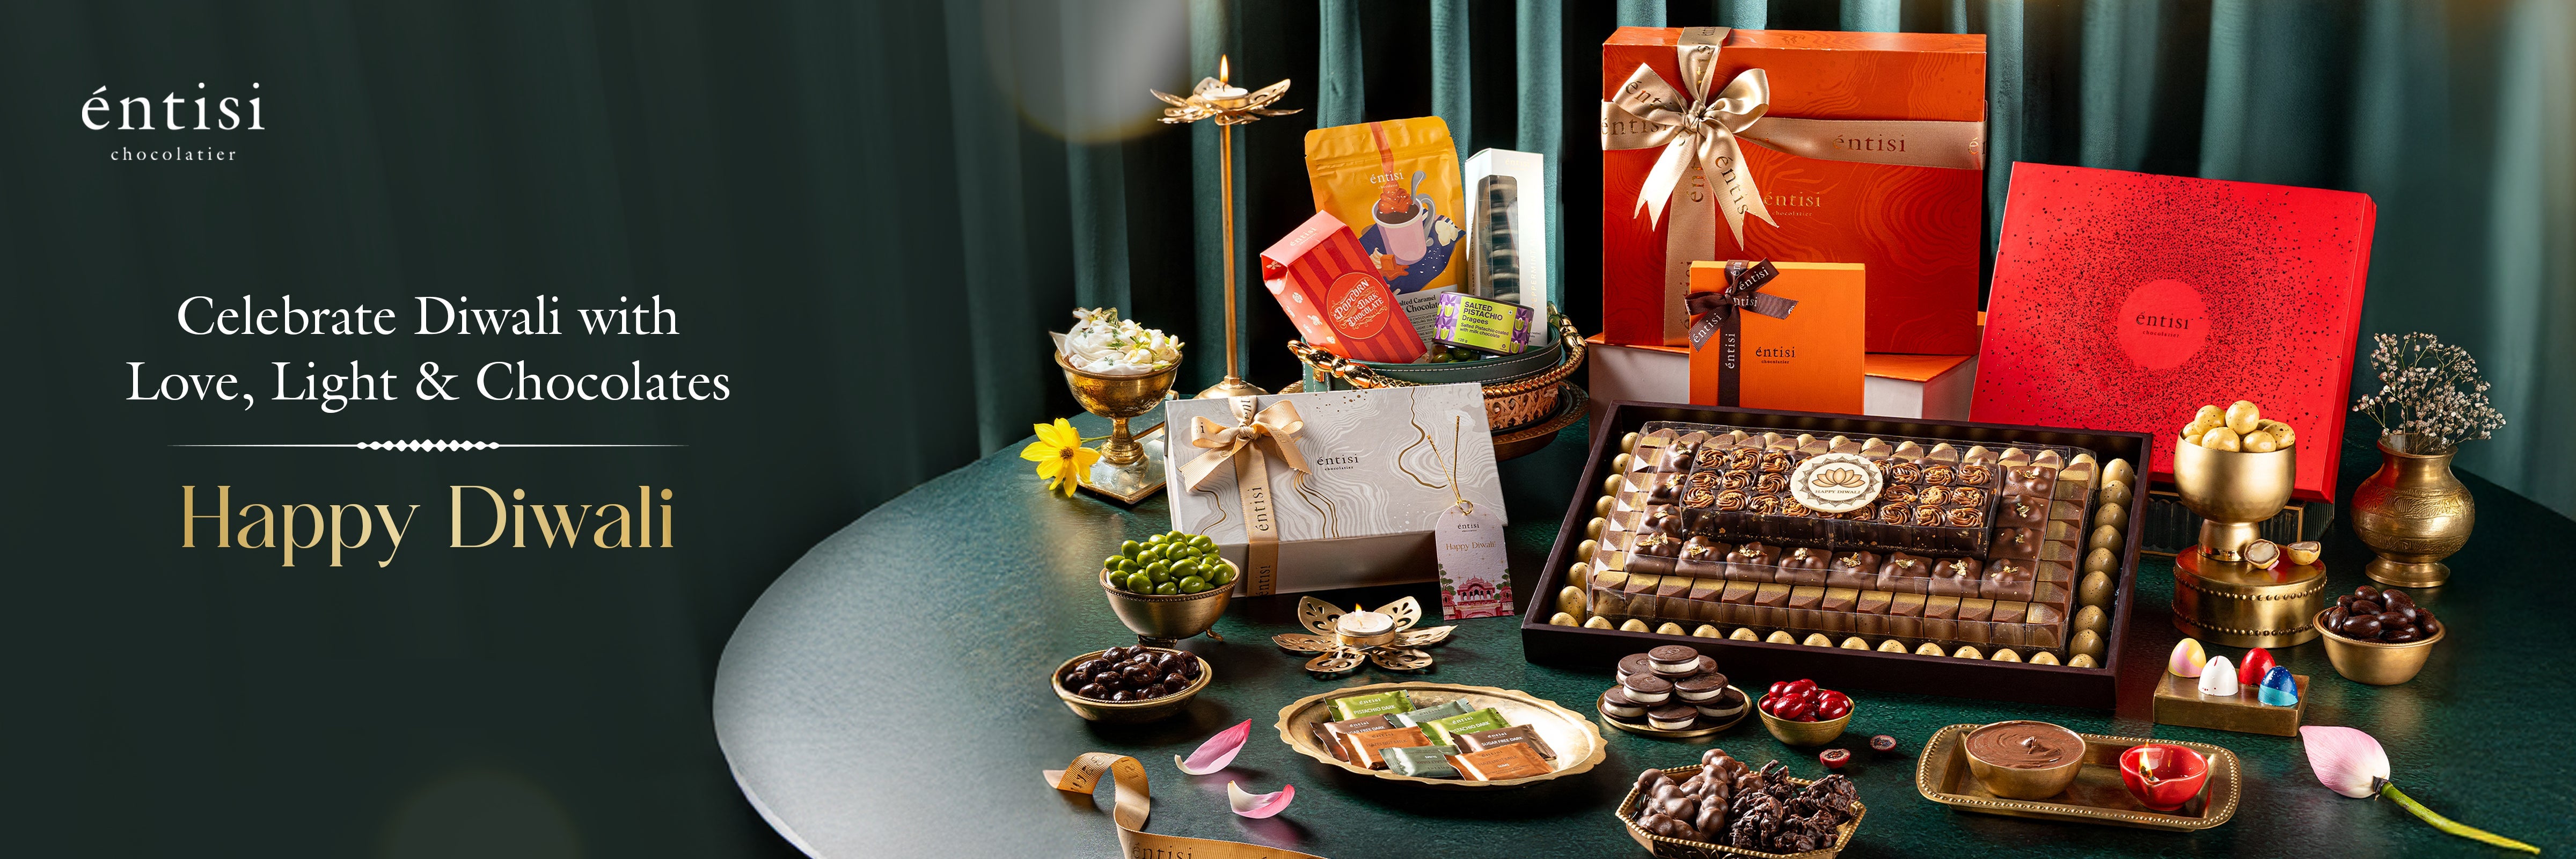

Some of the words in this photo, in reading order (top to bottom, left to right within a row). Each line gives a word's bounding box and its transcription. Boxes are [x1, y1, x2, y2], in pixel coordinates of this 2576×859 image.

[1832, 134, 1906, 152] éntisi
[1370, 169, 1404, 184] éntisi
[1763, 192, 1821, 207] éntisi
[1739, 266, 1769, 290] éntisi
[1333, 279, 1370, 320] POPCORN
[1357, 292, 1379, 310] DARK
[1399, 298, 1413, 306] alted
[1465, 301, 1492, 311] SALTED
[1733, 296, 1758, 307] ntisi
[1348, 297, 1385, 327] CHOCOLATE
[1463, 308, 1503, 321] PISTACHIO
[1462, 315, 1489, 325] Dragees
[2136, 311, 2189, 329] éntisi
[1694, 313, 1722, 343] éntisi
[1725, 333, 1735, 369] éntisi
[1756, 346, 1796, 357] éntisi
[1317, 454, 1359, 465] éntisi
[1247, 486, 1269, 531] éntisi
[1446, 543, 1469, 551] Happy
[1353, 707, 1381, 715] PISTACHIO
